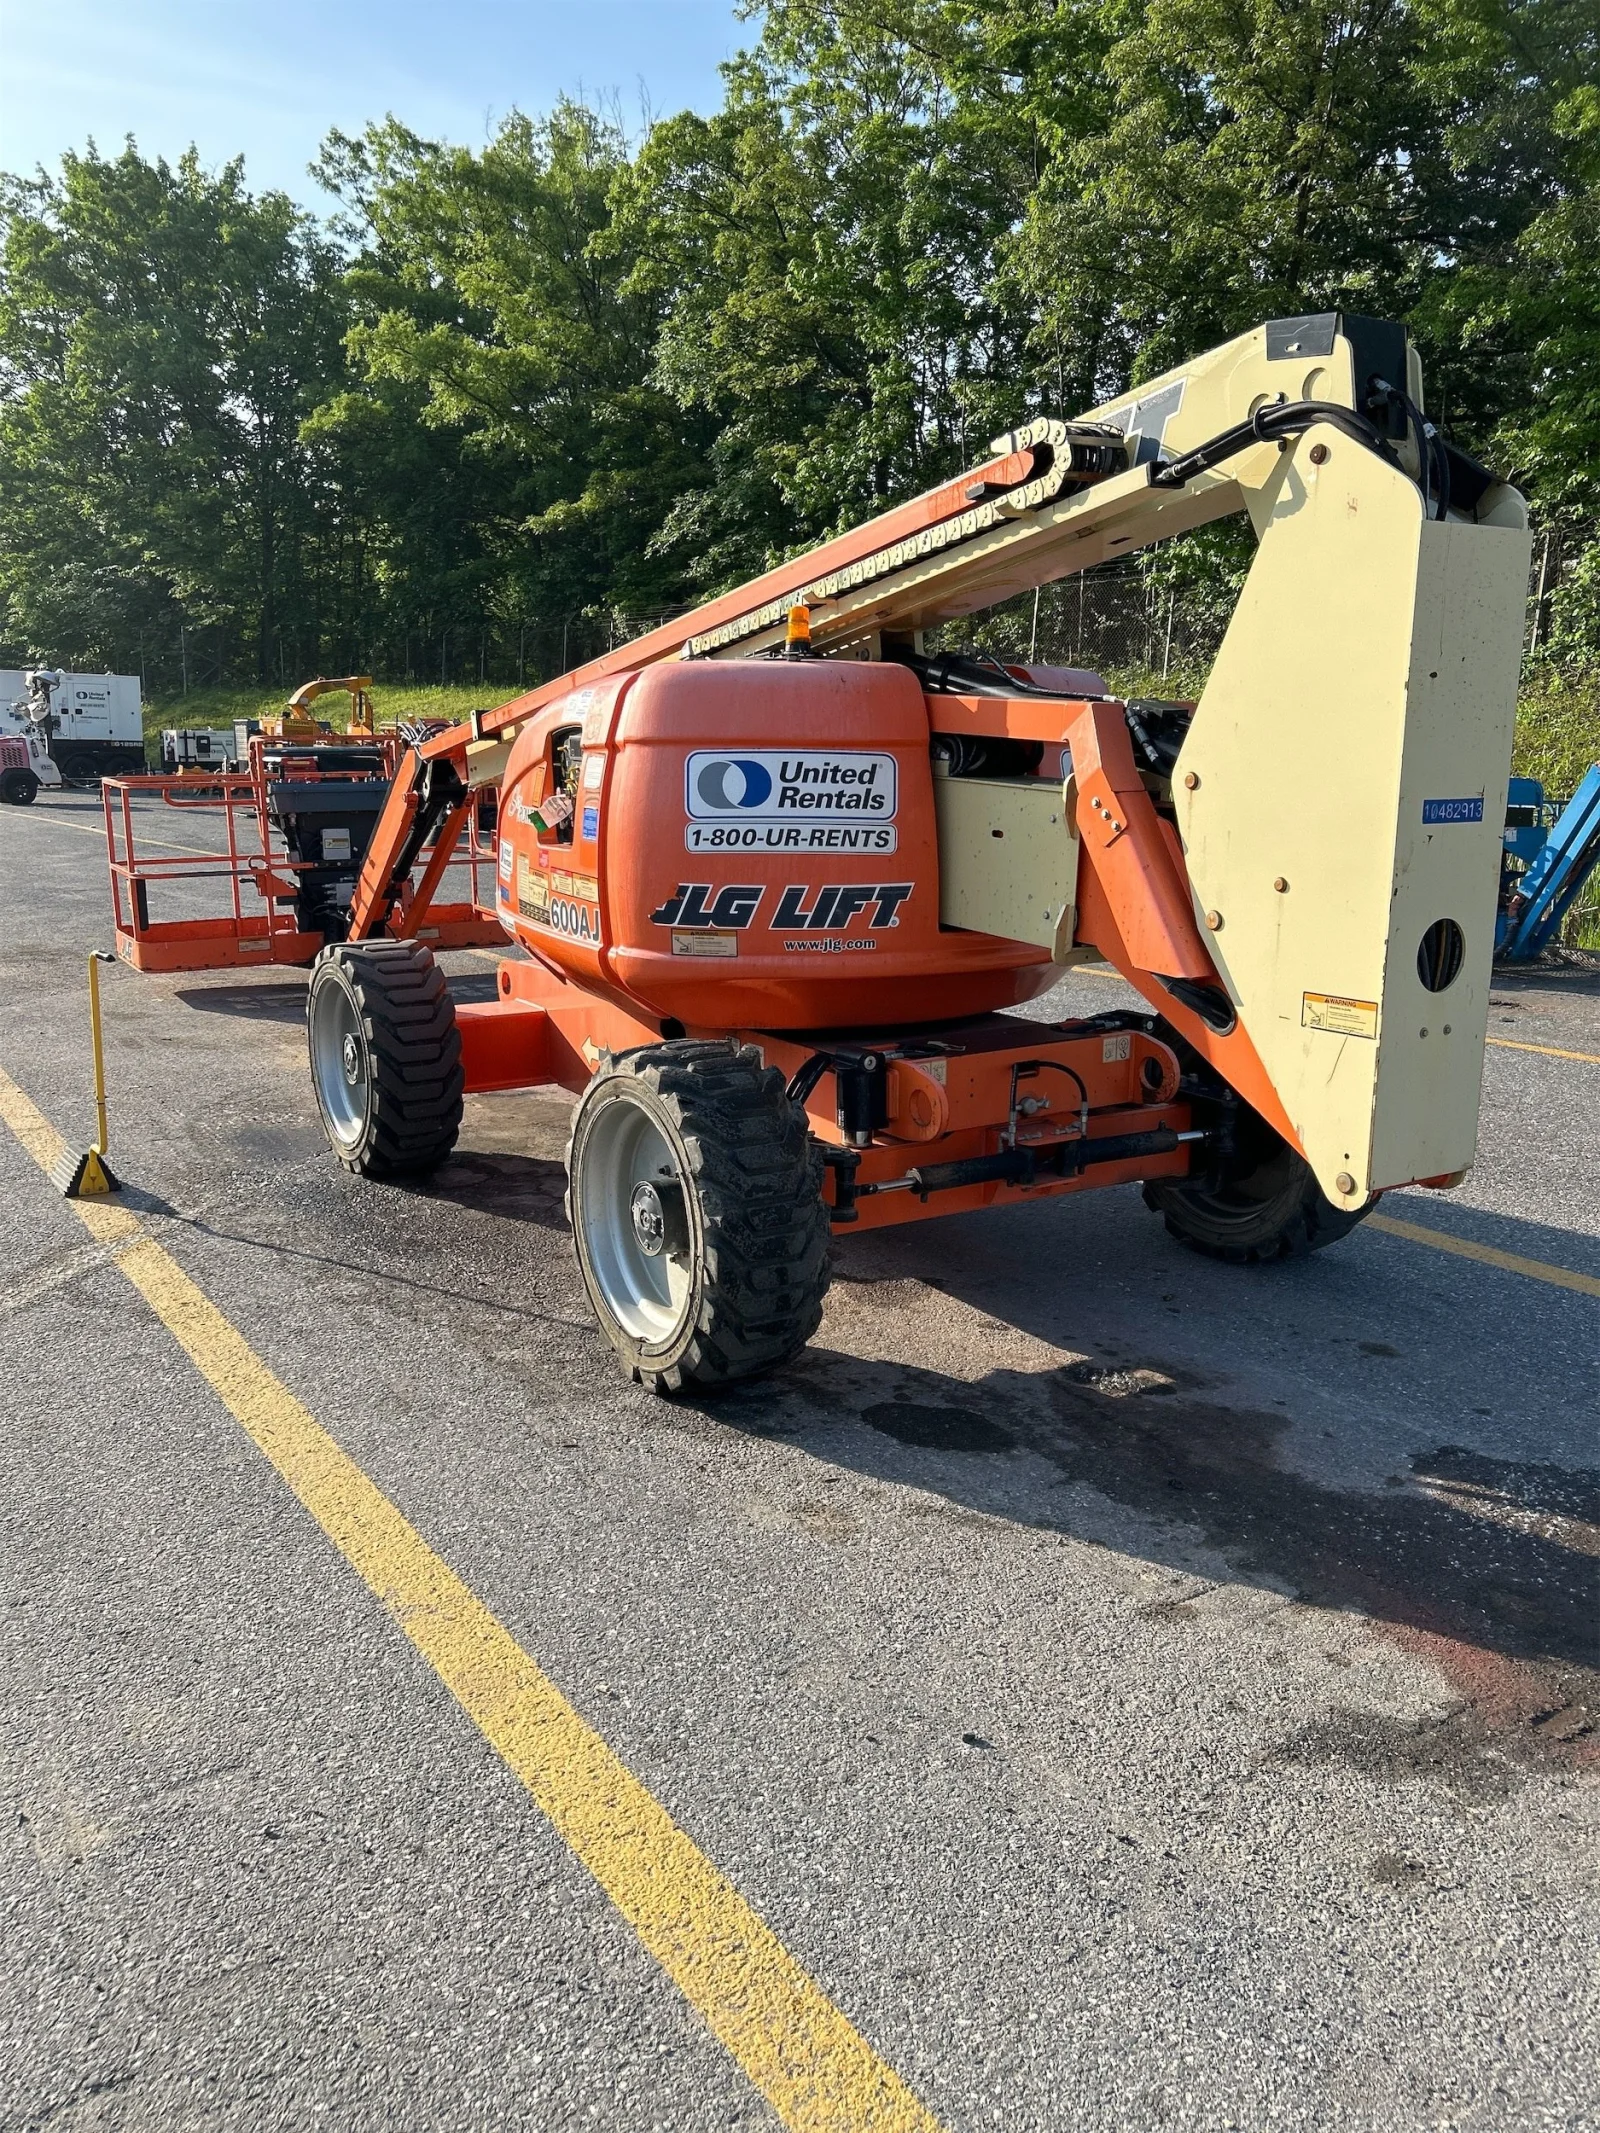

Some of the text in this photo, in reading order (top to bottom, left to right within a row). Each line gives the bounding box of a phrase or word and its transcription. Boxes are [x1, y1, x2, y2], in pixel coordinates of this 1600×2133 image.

[779, 761, 878, 785] United
[778, 786, 886, 810] Rentals
[1425, 802, 1482, 820] 10482913
[692, 828, 891, 848] 1-800-UR-RENTS
[648, 883, 767, 929] JLG
[769, 882, 915, 930] LIFT
[551, 898, 600, 942] 600AJ
[784, 938, 876, 951] www.jlg.com
[1330, 999, 1357, 1008] WARNING
